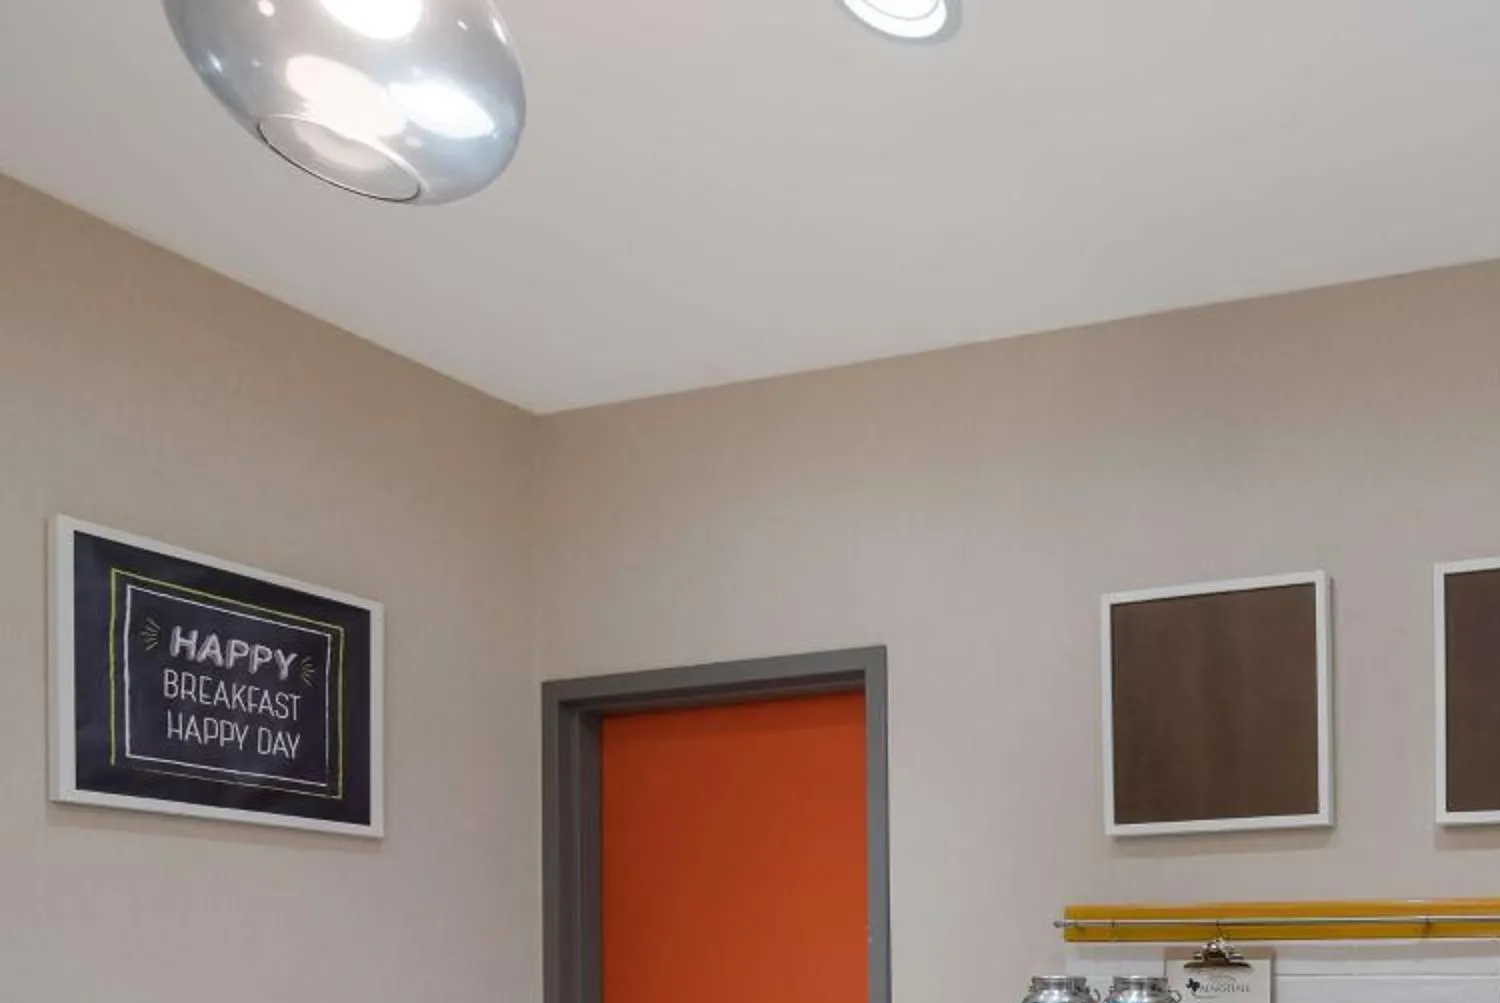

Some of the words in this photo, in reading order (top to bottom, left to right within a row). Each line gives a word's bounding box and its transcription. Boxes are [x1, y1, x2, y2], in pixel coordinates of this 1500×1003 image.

[169, 625, 298, 680] HAPPY
[163, 668, 302, 721] BREAKFAST
[166, 709, 249, 751] HAPPY
[257, 727, 301, 760] DAY
